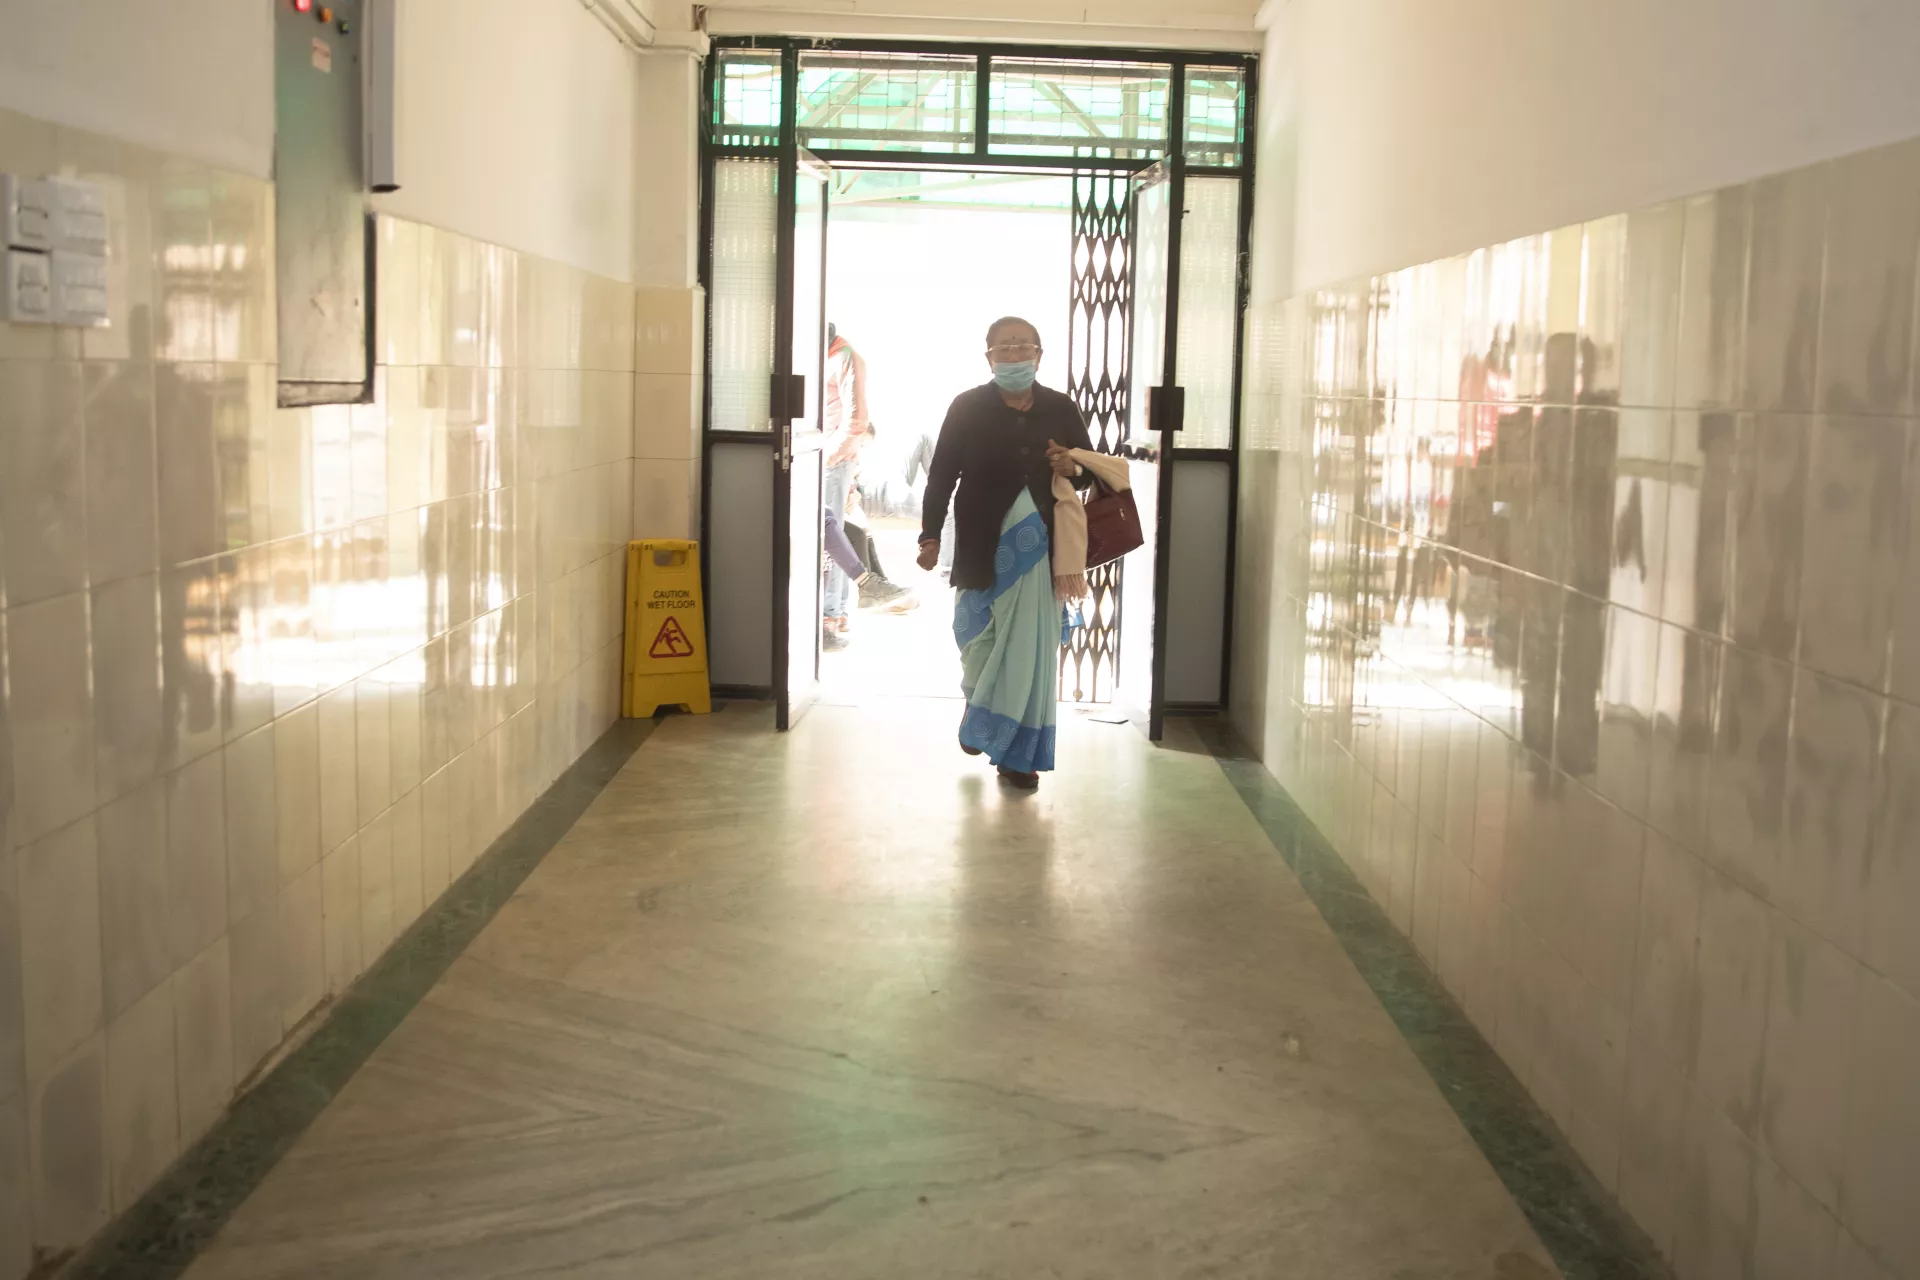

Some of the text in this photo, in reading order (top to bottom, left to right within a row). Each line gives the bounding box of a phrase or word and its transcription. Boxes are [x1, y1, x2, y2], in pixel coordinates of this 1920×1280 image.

[653, 590, 690, 599] CAUTION
[647, 600, 696, 609] WET FLOOR
